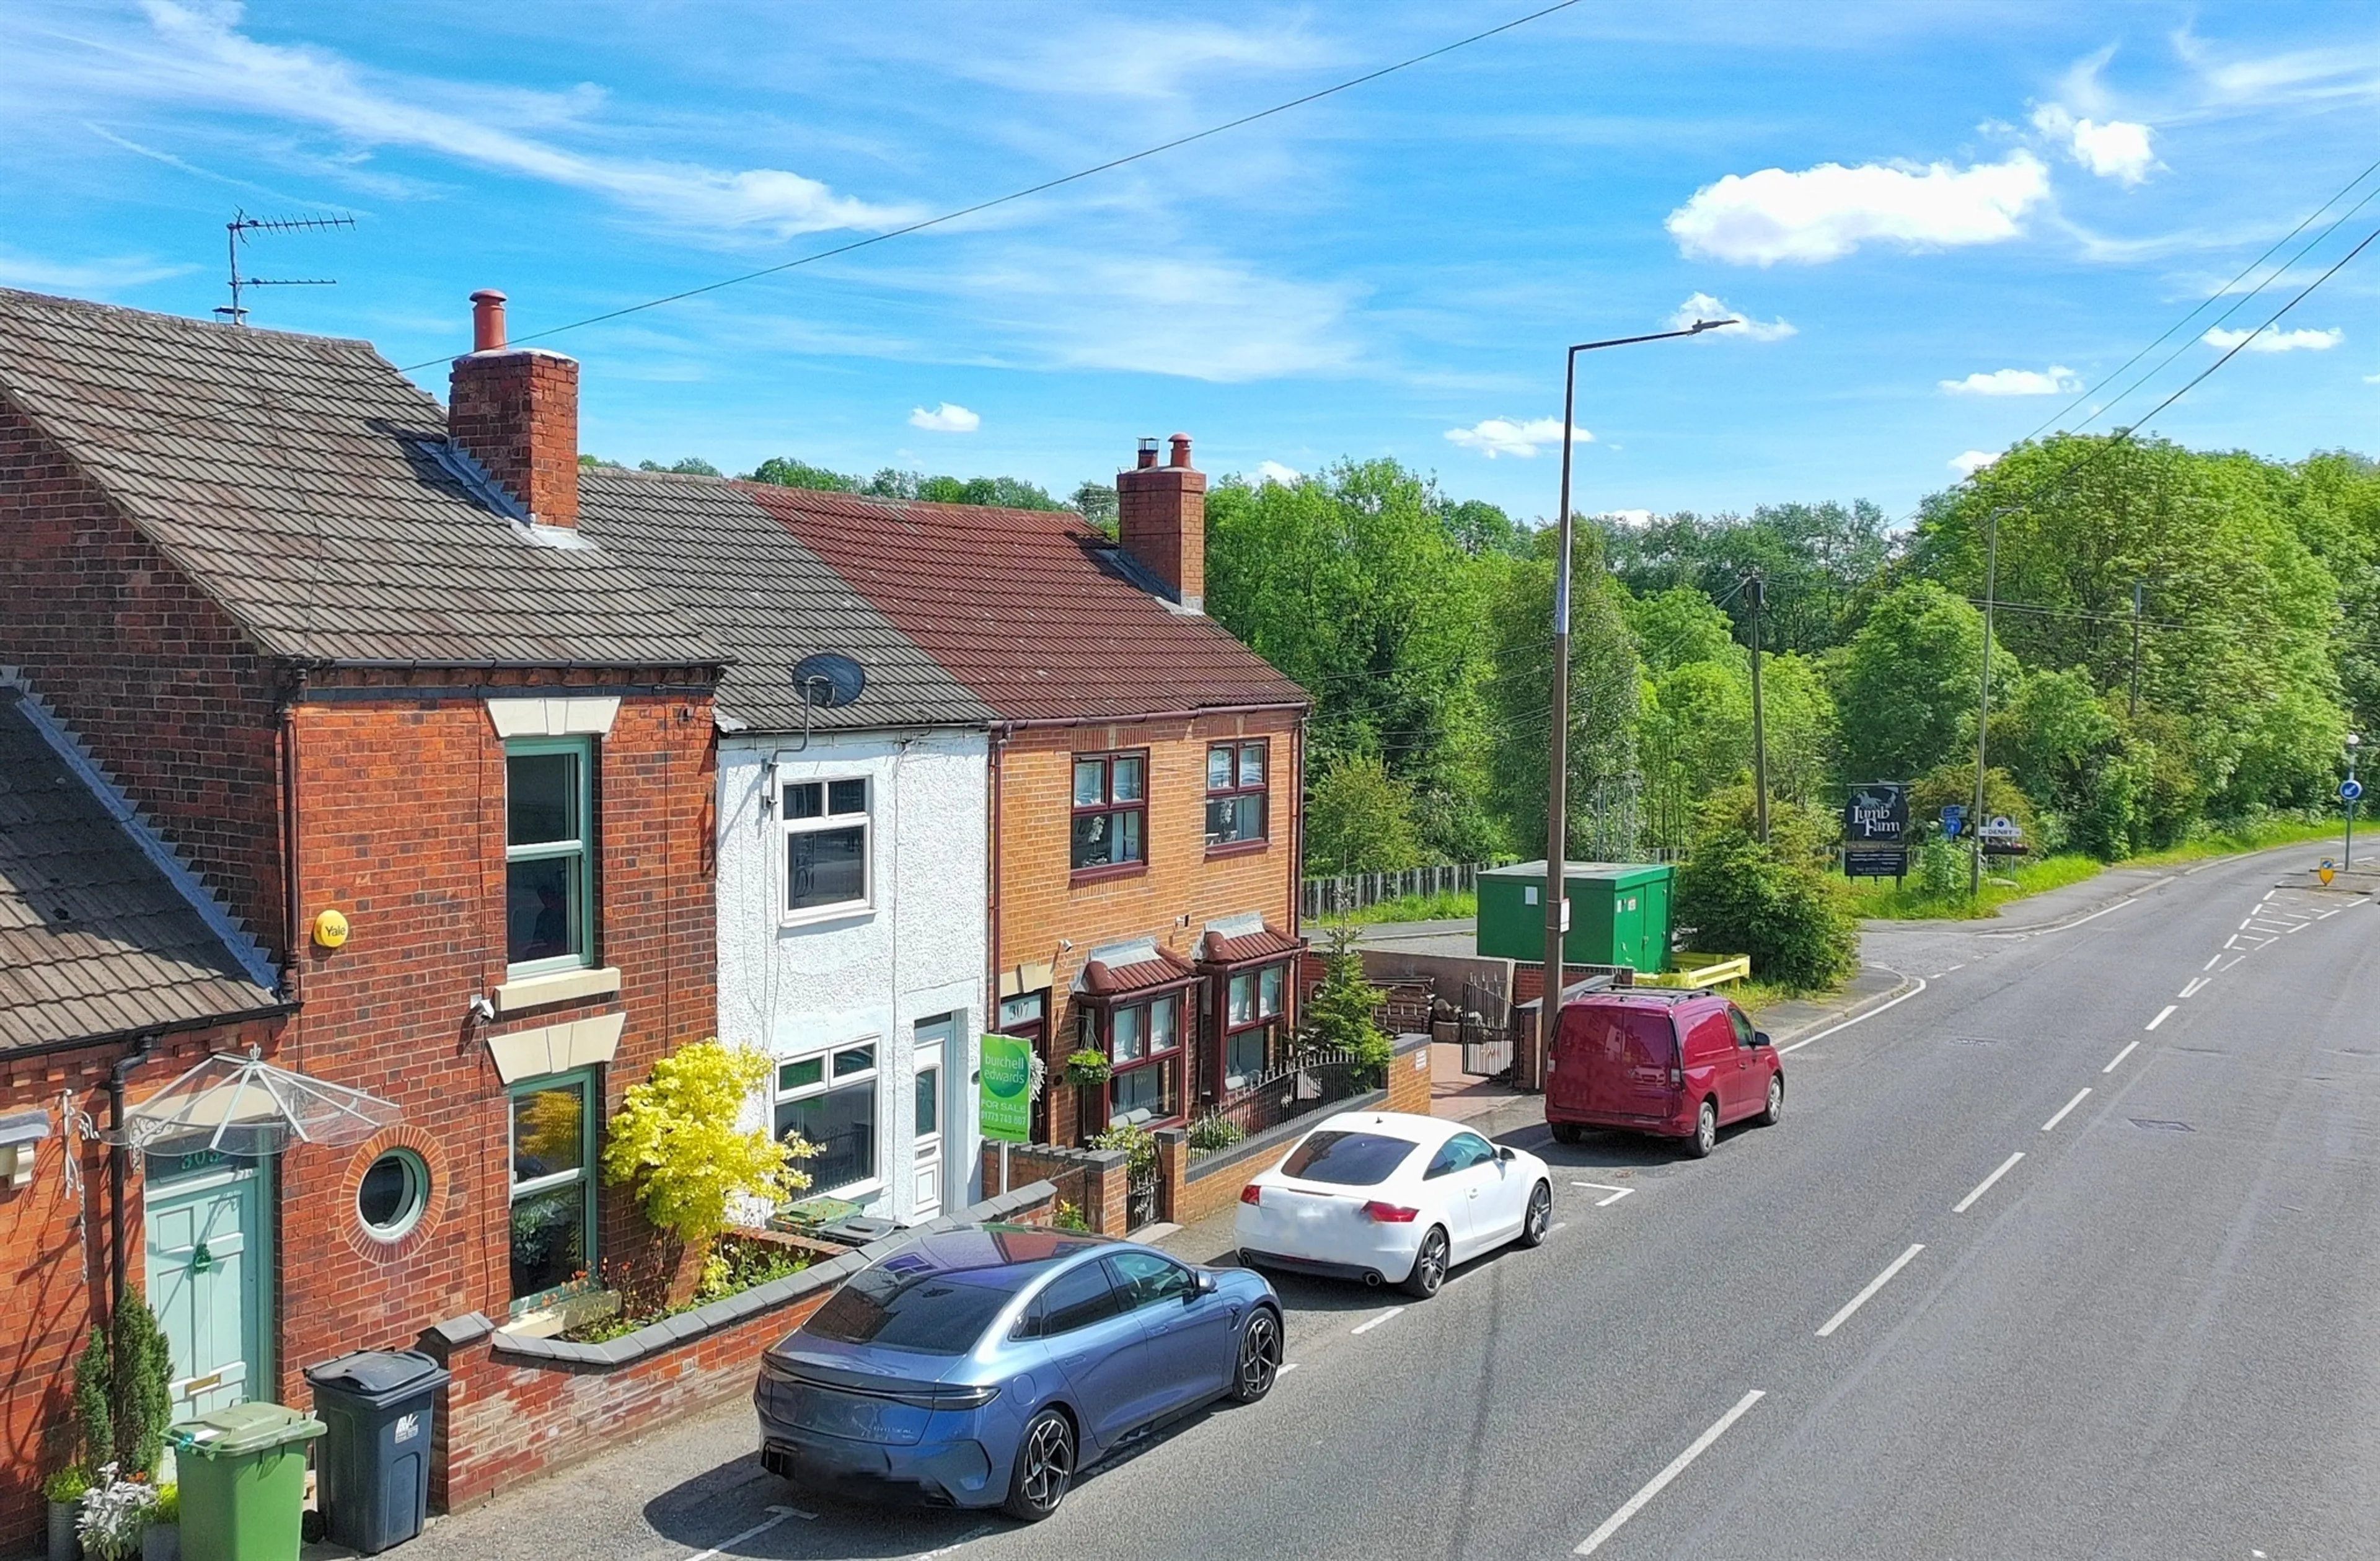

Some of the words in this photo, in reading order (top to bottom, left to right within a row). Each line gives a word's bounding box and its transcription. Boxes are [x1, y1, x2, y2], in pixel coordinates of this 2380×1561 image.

[1853, 805, 1890, 824] Lumb
[325, 926, 346, 937] Yale
[1008, 1001, 1029, 1020] 307
[985, 1053, 1024, 1069] burchell
[984, 1069, 1025, 1084] edwards
[981, 1099, 999, 1110] FOR
[1000, 1103, 1026, 1113] SALE
